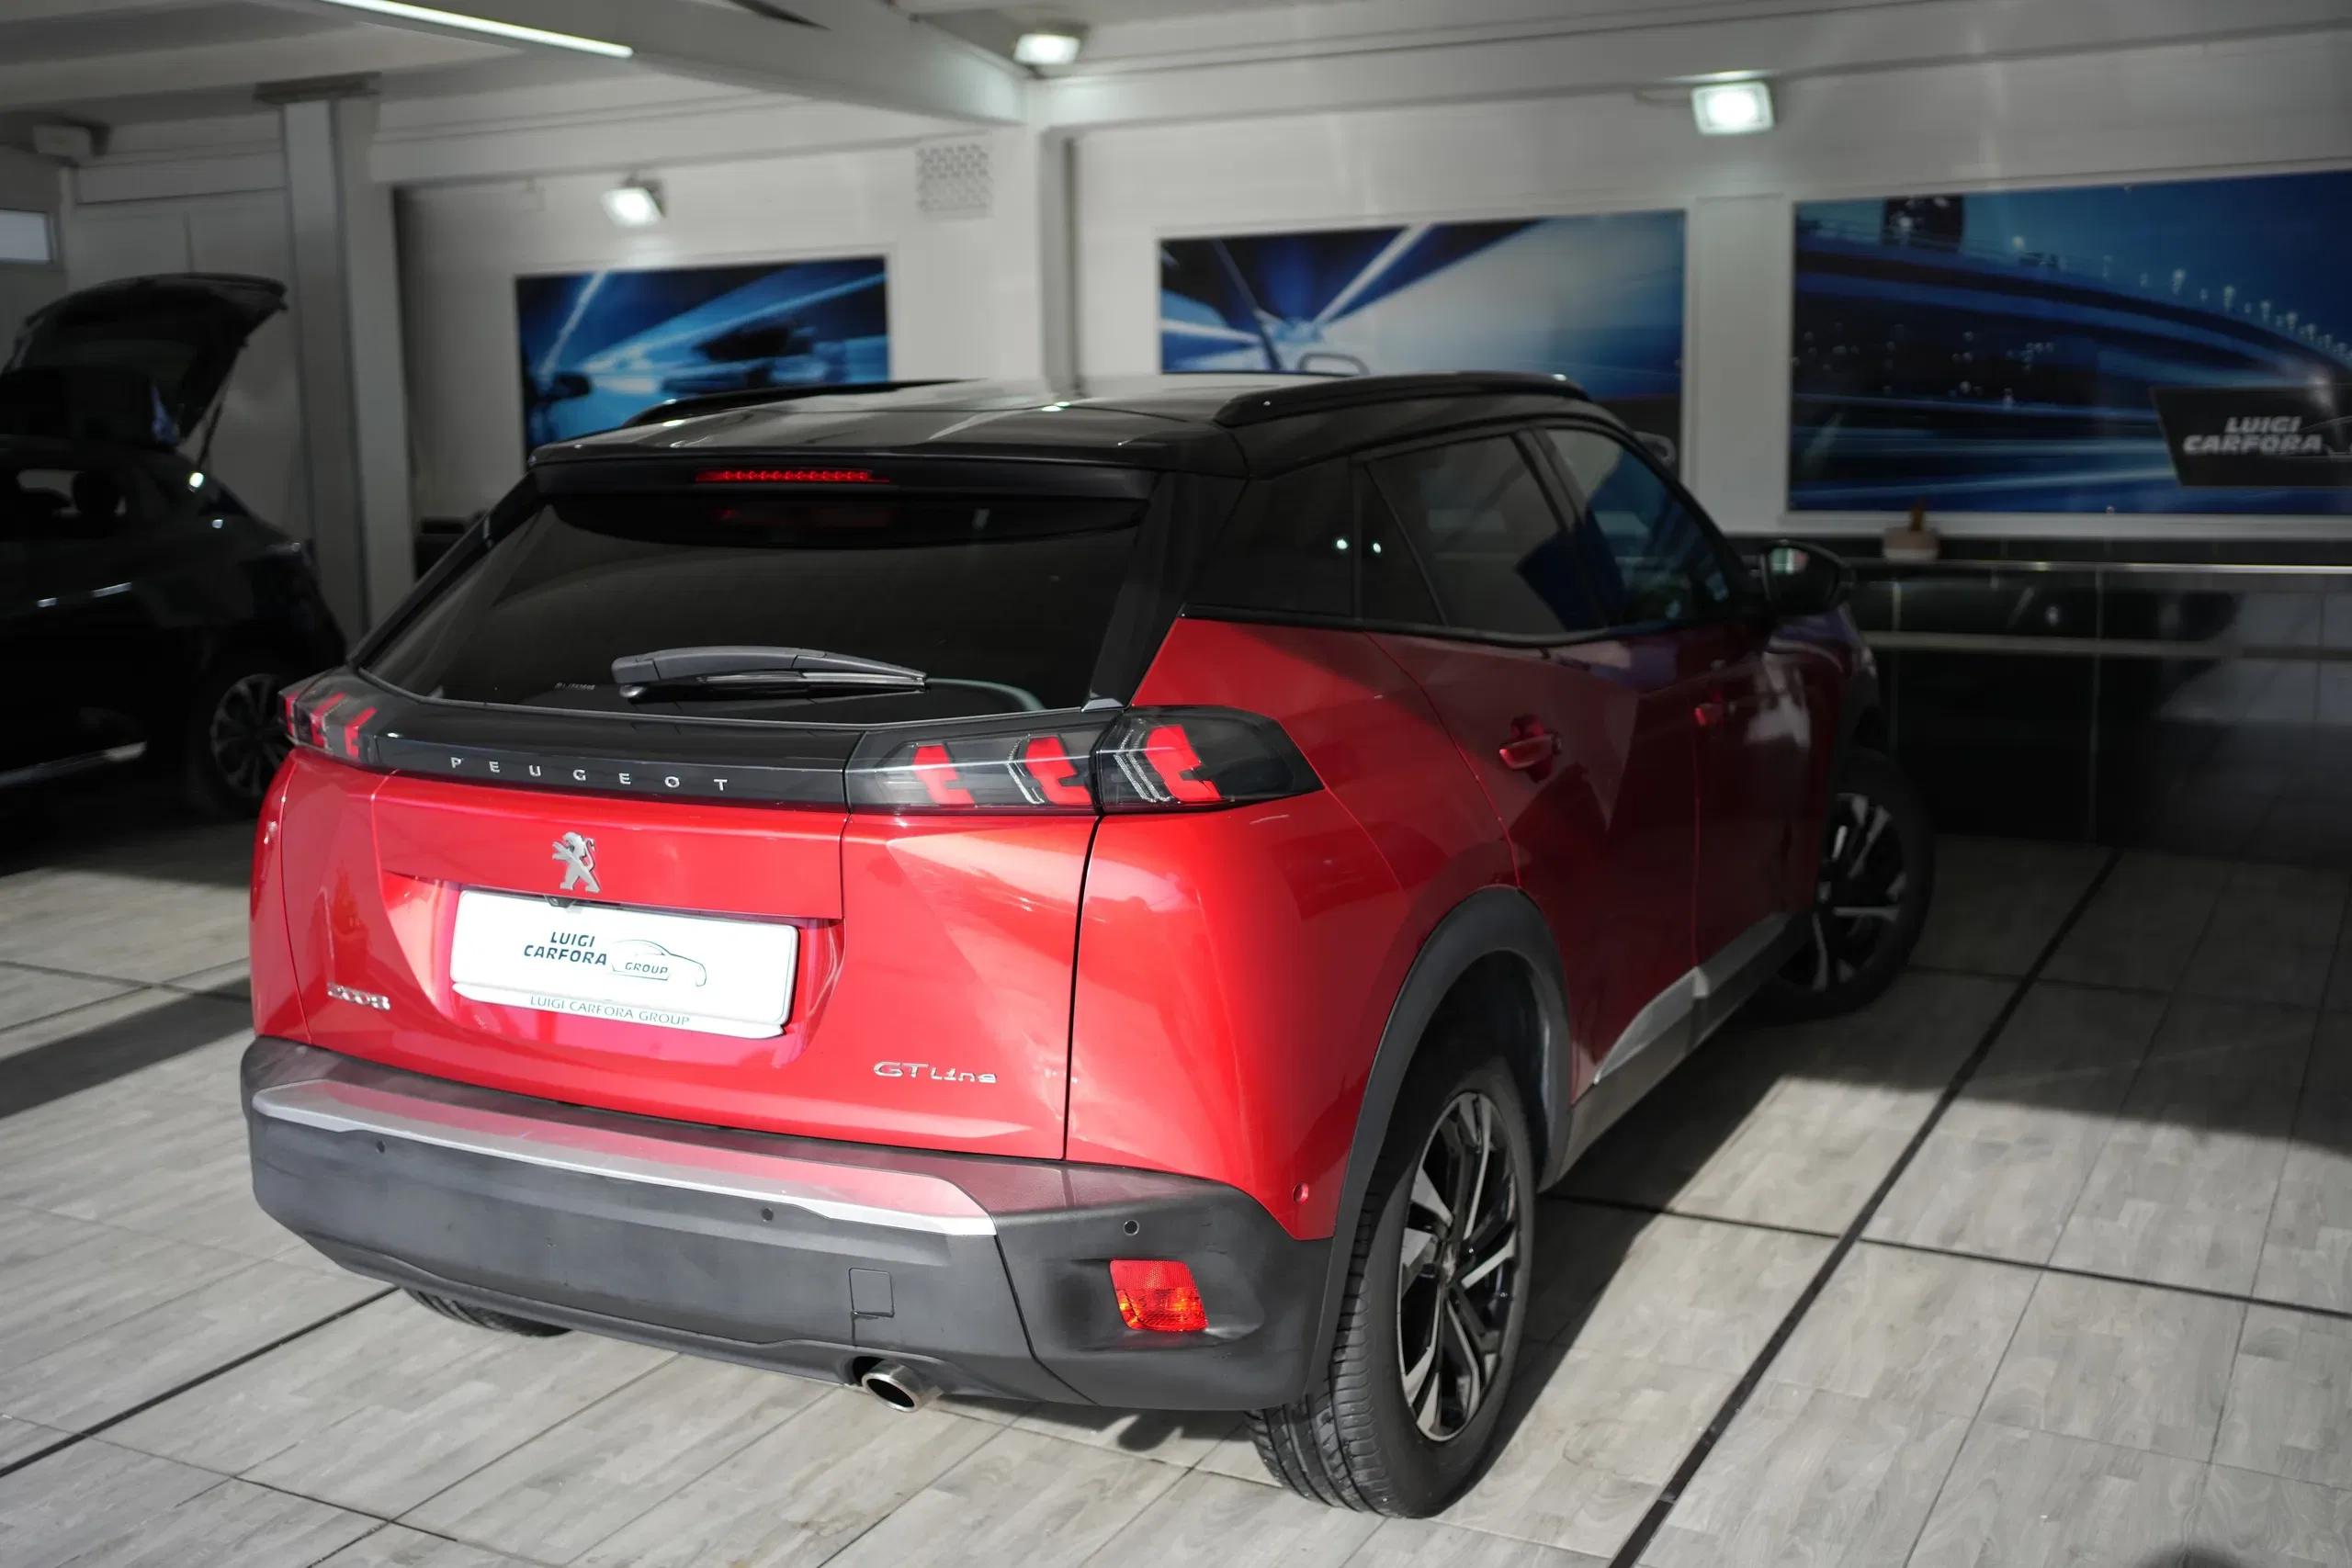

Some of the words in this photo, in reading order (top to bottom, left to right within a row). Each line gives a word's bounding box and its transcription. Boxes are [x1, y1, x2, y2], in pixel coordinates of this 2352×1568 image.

[2223, 416, 2302, 434] LUIGI
[2182, 434, 2323, 456] CARFORA
[450, 756, 728, 792] PEUGEOT
[549, 931, 595, 948] LUIGI
[524, 944, 607, 965] CARFORA
[625, 962, 669, 975] GROUP
[530, 996, 565, 1010] LUIGI
[569, 1001, 634, 1019] CARFORA
[639, 1010, 690, 1026] GROUP
